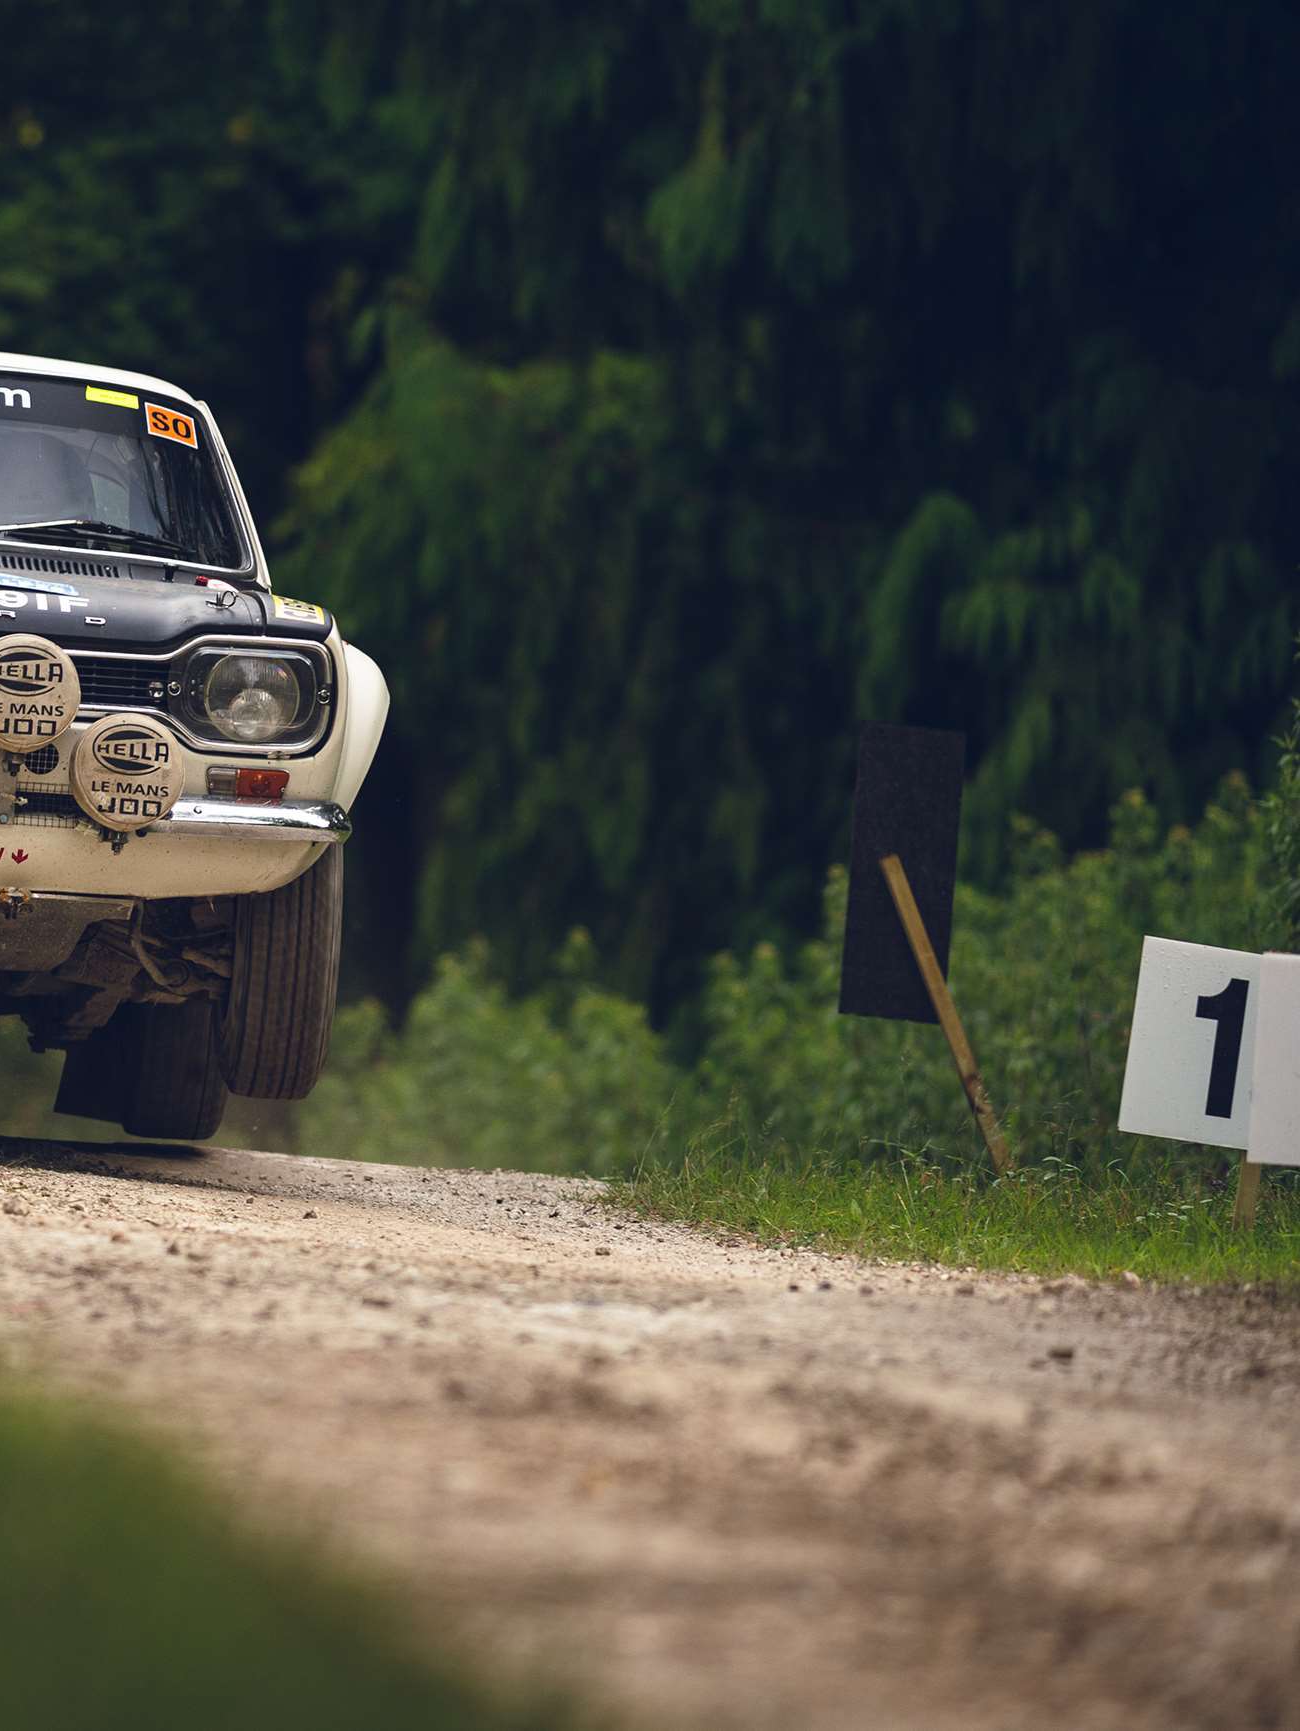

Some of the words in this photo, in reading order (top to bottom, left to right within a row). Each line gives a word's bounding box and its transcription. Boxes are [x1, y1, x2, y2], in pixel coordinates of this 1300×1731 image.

[10, 703, 64, 717] MANS
[97, 743, 169, 763] HELLA
[91, 780, 110, 793] LE
[116, 782, 169, 797] MANS
[1195, 978, 1250, 1119] 1
